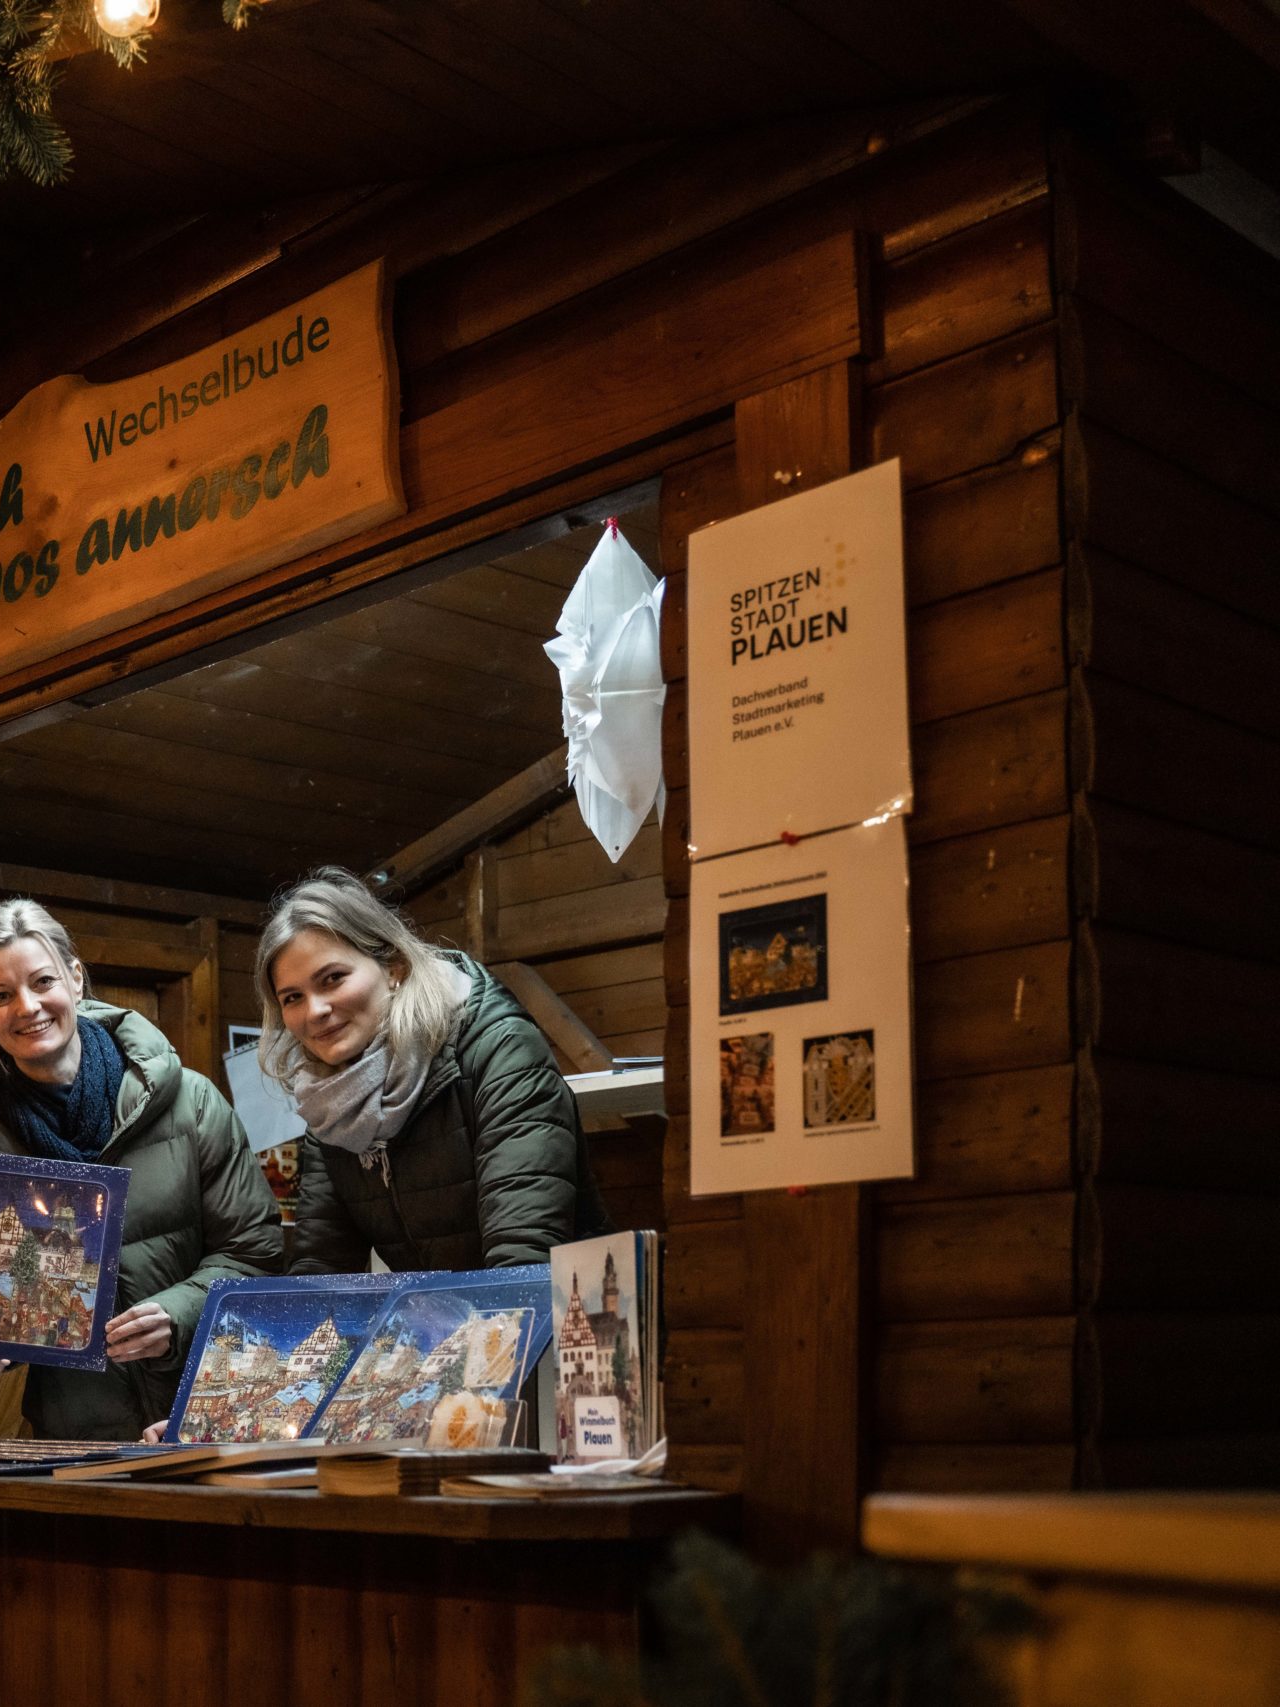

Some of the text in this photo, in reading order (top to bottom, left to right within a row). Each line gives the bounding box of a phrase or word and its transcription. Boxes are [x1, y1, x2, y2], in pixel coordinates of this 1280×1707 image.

[84, 315, 331, 463] Wechselbude
[75, 403, 330, 575] annersch
[730, 567, 821, 613] SPITZEN
[730, 597, 800, 636] STADT
[731, 606, 848, 666] PLAUEN
[732, 676, 809, 708] Dachverband
[732, 692, 825, 725] Stadtmarketing
[732, 716, 794, 742] Plauen e.V.
[583, 1430, 613, 1445] Plauen
